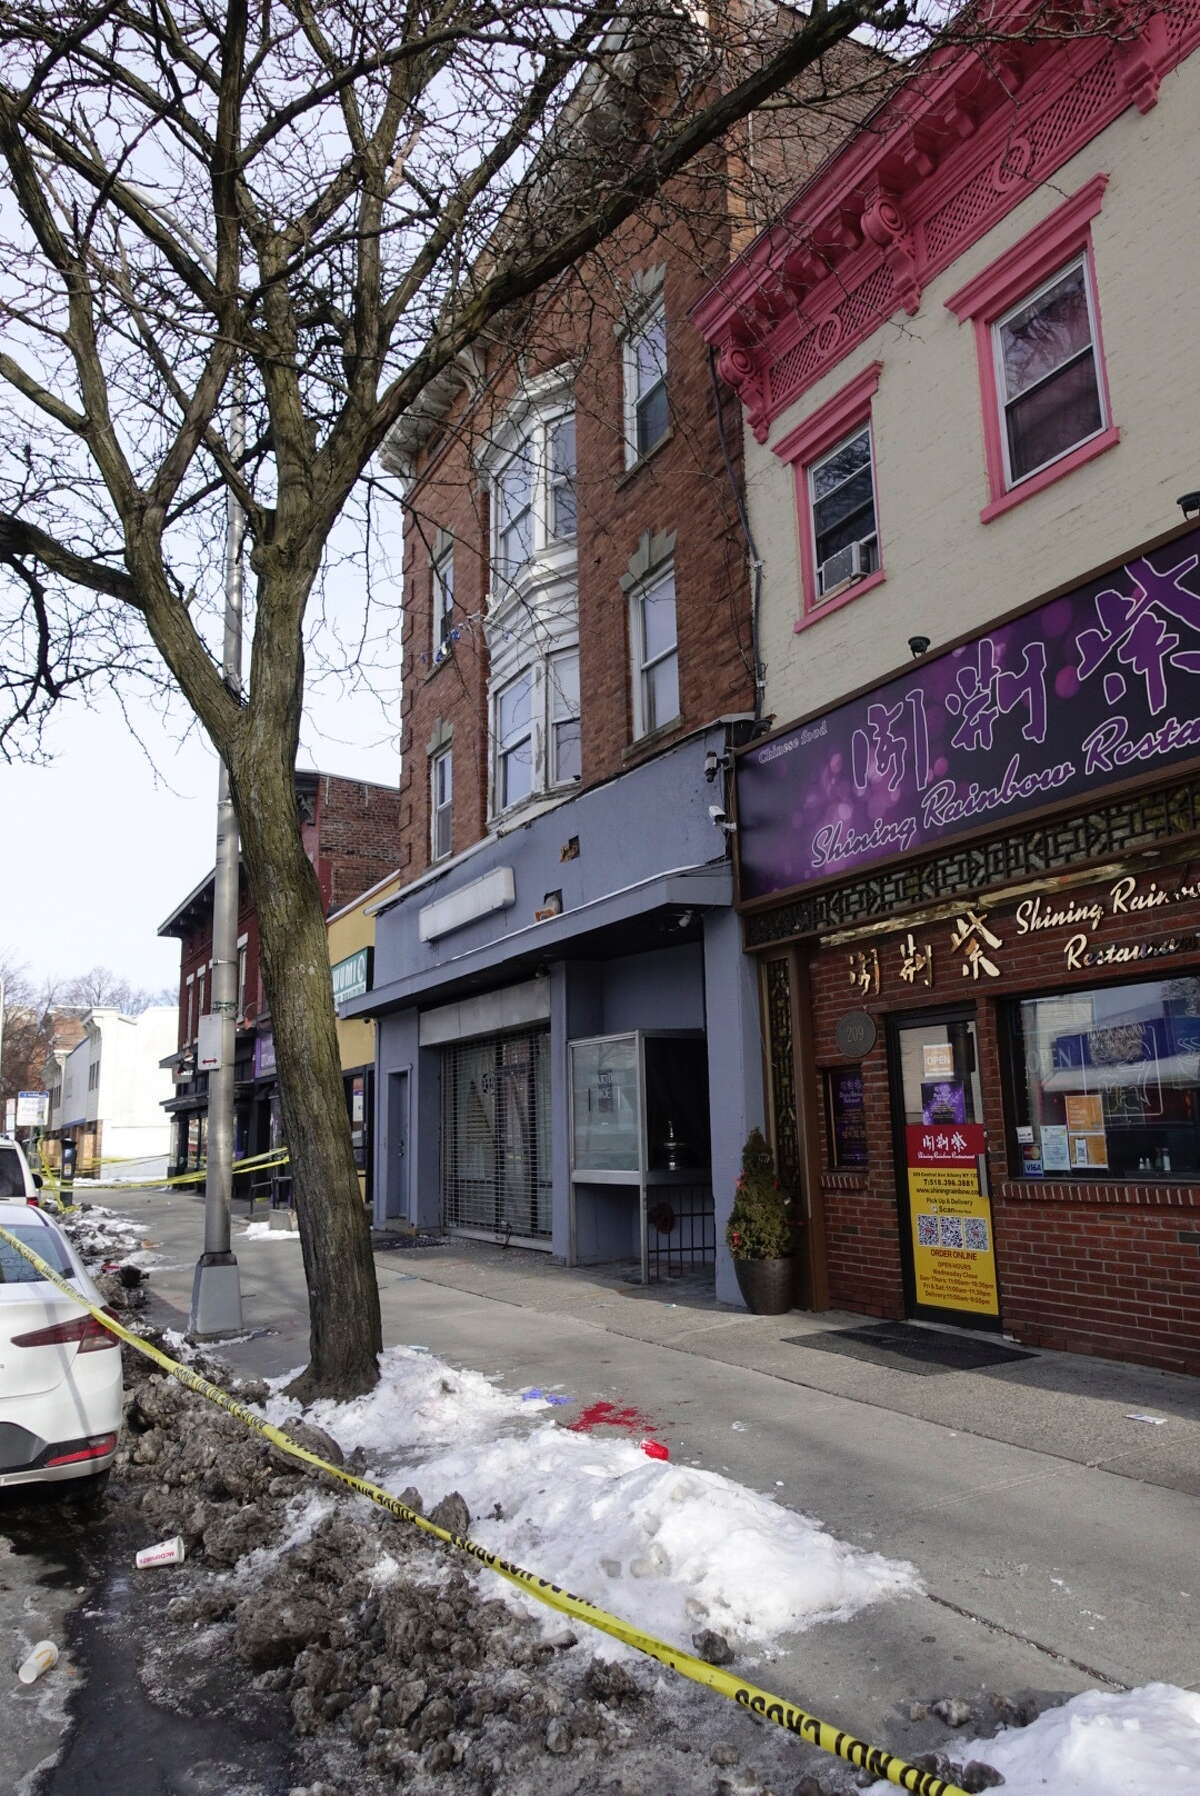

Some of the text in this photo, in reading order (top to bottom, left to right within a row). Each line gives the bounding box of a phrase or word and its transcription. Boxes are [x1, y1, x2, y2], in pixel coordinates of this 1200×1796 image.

[811, 818, 916, 867] Shining
[921, 753, 1075, 829] Rainbow
[1016, 897, 1105, 935] Shining
[847, 1024, 864, 1043] 209
[927, 1055, 950, 1066] OPEN
[1026, 1163, 1041, 1171] VISA
[930, 1249, 977, 1261] ORDER ONLINE
